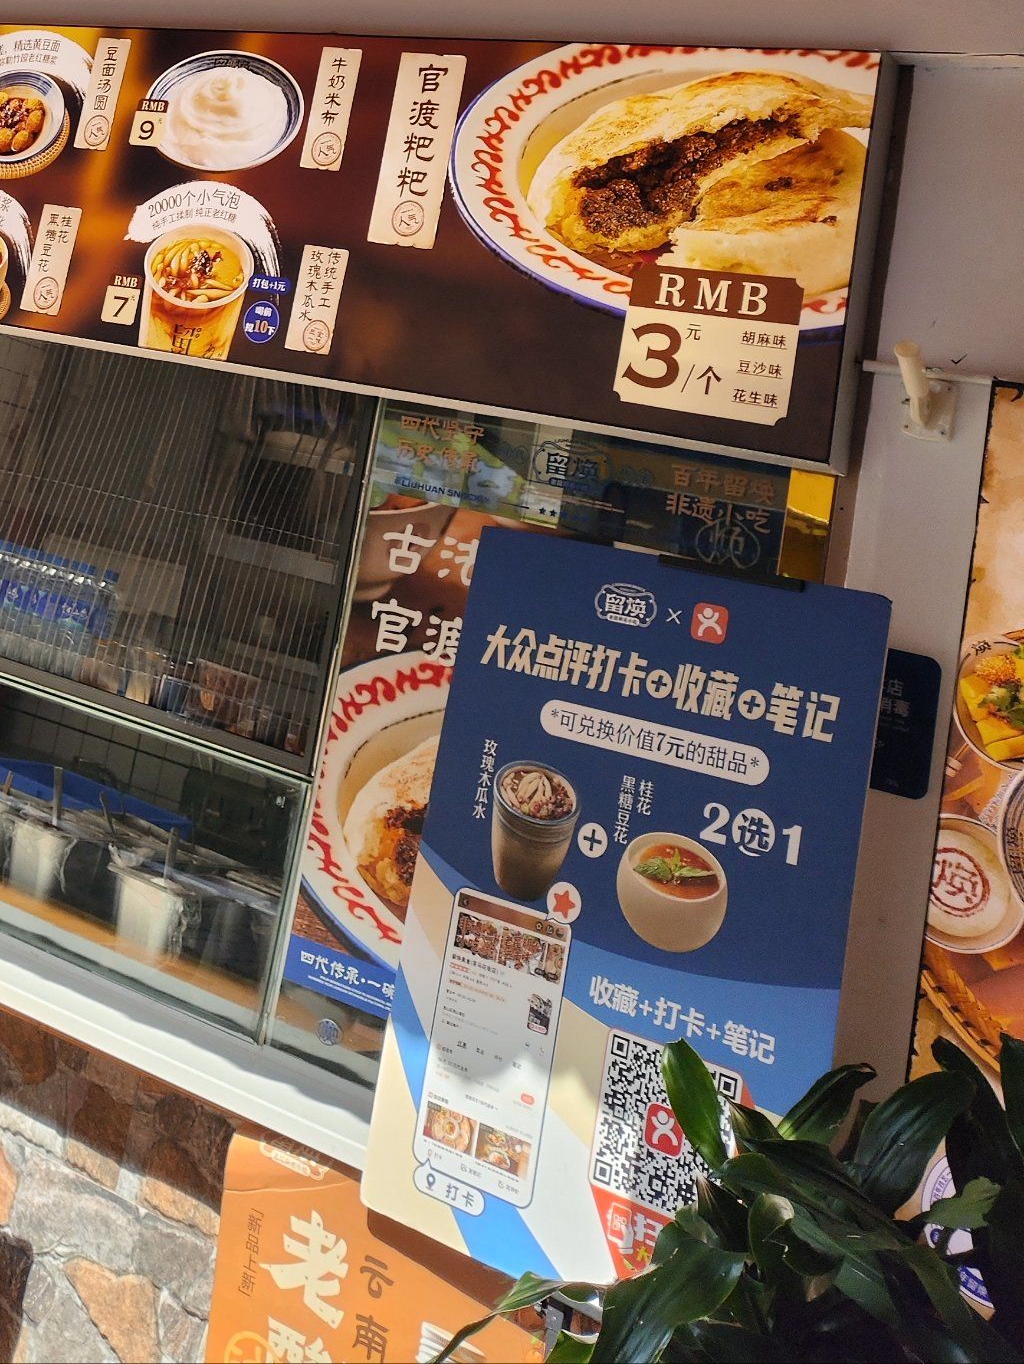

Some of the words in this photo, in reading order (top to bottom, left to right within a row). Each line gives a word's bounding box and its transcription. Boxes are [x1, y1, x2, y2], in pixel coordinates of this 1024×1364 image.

[93, 45, 119, 111] 豆面汤圆
[320, 57, 348, 128] 牛奶米布
[141, 100, 166, 112] RMB
[137, 120, 155, 141] 9
[396, 63, 449, 198] 官渡粑粑
[148, 188, 242, 218] 20000个小气泡
[37, 213, 60, 273] 黑糖豆花
[57, 216, 73, 244] 桂花
[113, 274, 138, 288] RMB
[252, 277, 286, 292] 打包+1元
[298, 249, 324, 322] 玫瑰木瓜水
[317, 251, 342, 309] 传统手工
[654, 273, 771, 316] RMB
[112, 295, 130, 318] 7
[621, 322, 682, 389] 3
[685, 323, 702, 342] 元
[741, 330, 787, 349] 胡麻味
[737, 359, 783, 378] 豆沙味
[732, 387, 779, 408] 花生味
[665, 491, 771, 534] 非遗小吃
[604, 593, 647, 619] 留焕
[471, 738, 499, 820] 玫瑰木瓜水
[635, 778, 655, 817] 桂花
[612, 774, 637, 845] 黑糖豆花
[699, 801, 804, 866] 2选1
[588, 974, 776, 1066] 收藏+打卡+笔记
[445, 1182, 475, 1208] 打卡
[355, 1254, 395, 1362] 云南
